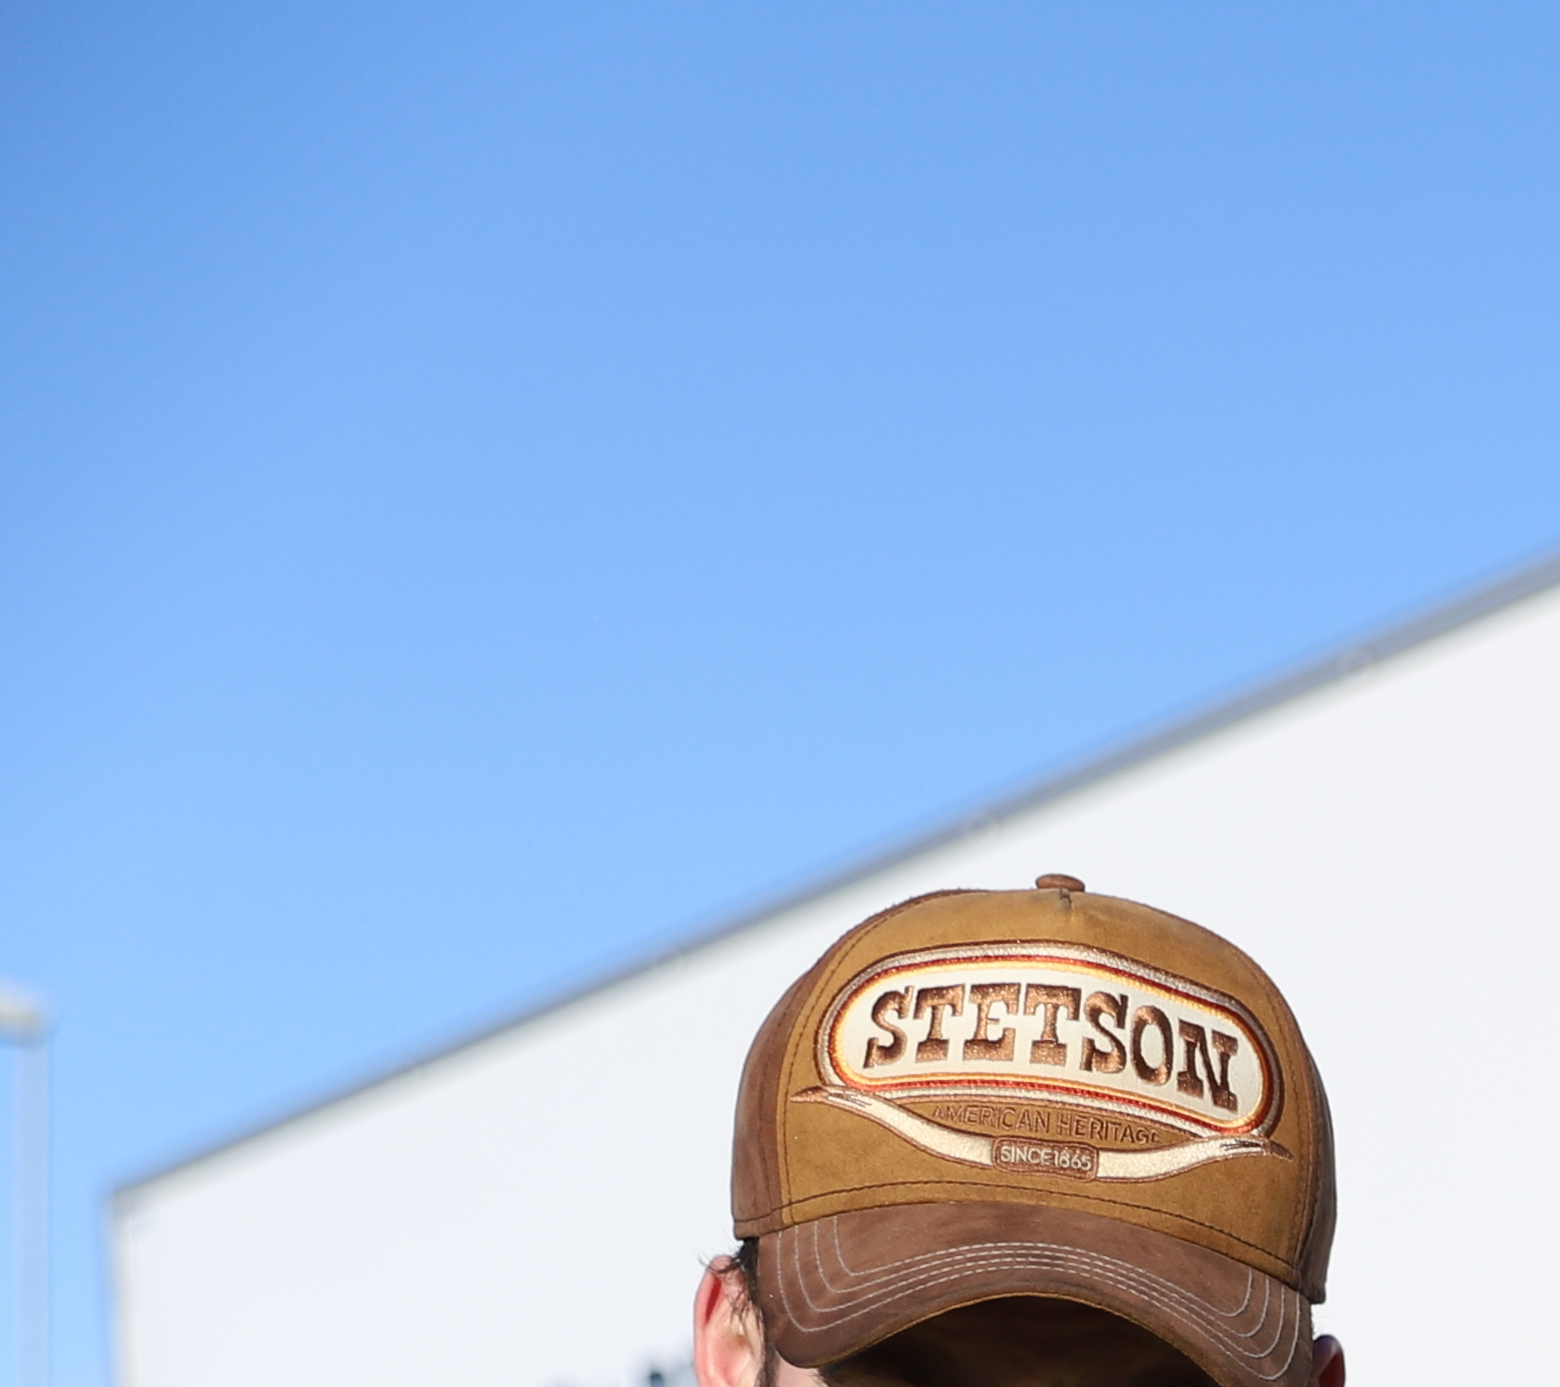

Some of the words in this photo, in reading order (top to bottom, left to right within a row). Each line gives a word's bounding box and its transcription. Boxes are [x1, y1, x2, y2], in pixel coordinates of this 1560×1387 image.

[863, 981, 1240, 1113] STETSON
[932, 1104, 1051, 1134] AMERICAN
[1056, 1115, 1162, 1145] HERITAGE
